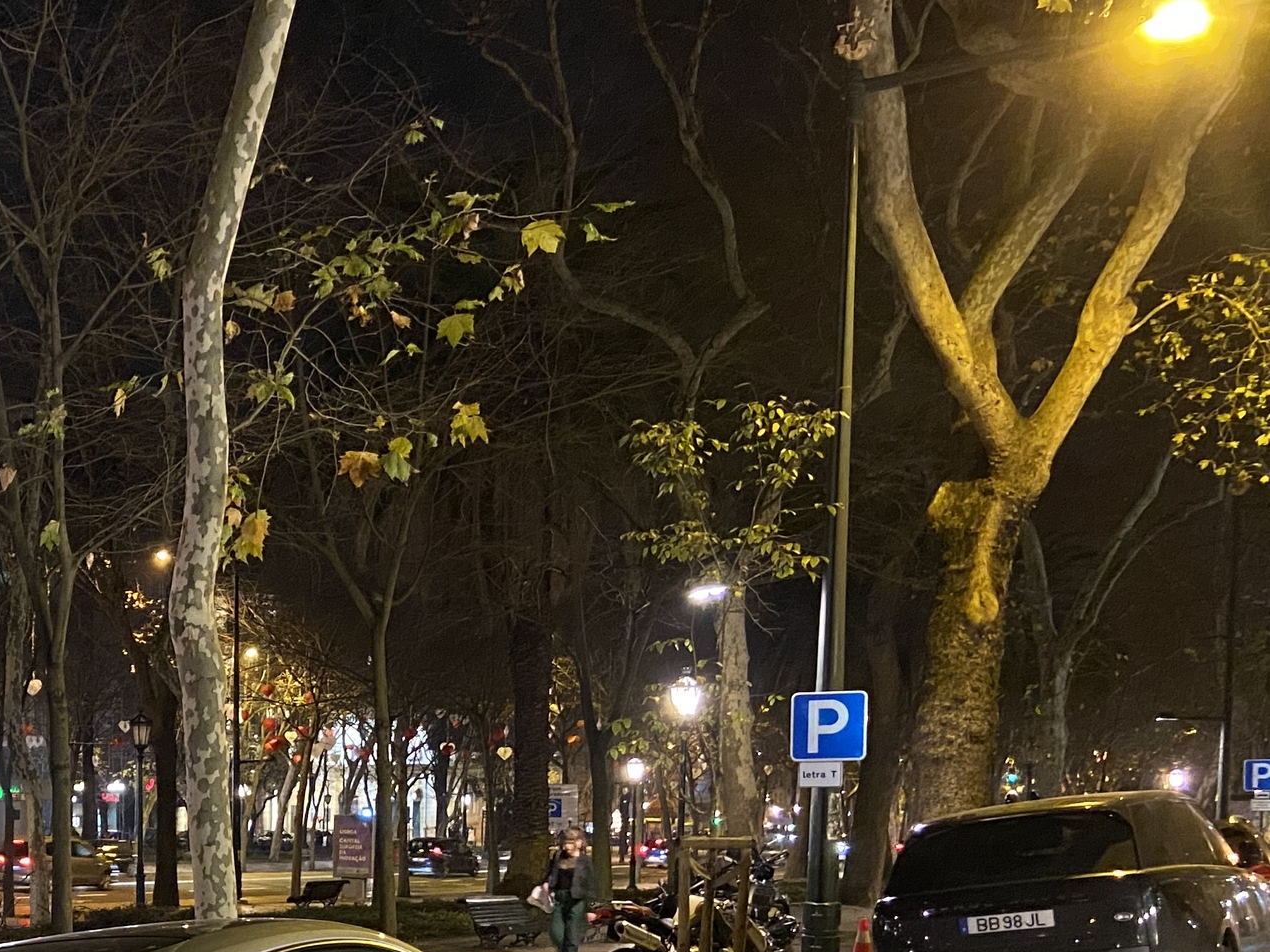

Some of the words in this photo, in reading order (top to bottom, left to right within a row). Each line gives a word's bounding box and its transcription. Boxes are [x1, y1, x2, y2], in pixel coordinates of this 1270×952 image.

[807, 699, 849, 753] P
[802, 771, 826, 779] letra
[831, 770, 837, 778] T
[1252, 763, 1270, 788] P
[976, 917, 1000, 932] BB
[1003, 915, 1023, 929] 98
[1025, 913, 1047, 927] JL
